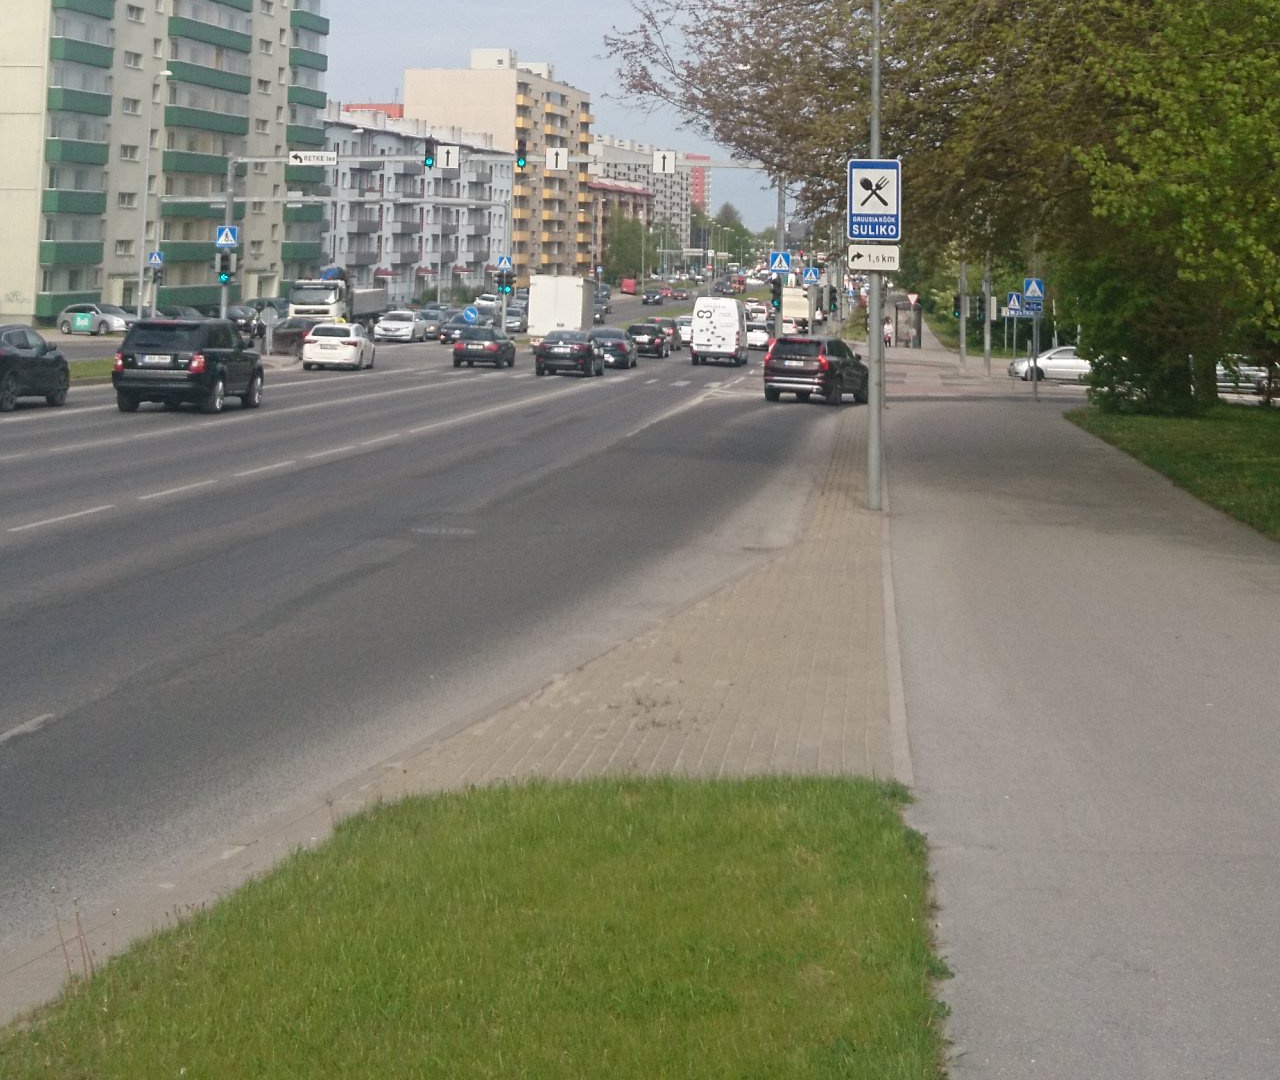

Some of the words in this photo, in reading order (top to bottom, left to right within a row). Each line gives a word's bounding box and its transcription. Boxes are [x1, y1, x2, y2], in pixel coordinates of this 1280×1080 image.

[852, 224, 897, 235] SULIKO
[868, 253, 880, 264] 1,5
[882, 253, 895, 263] km
